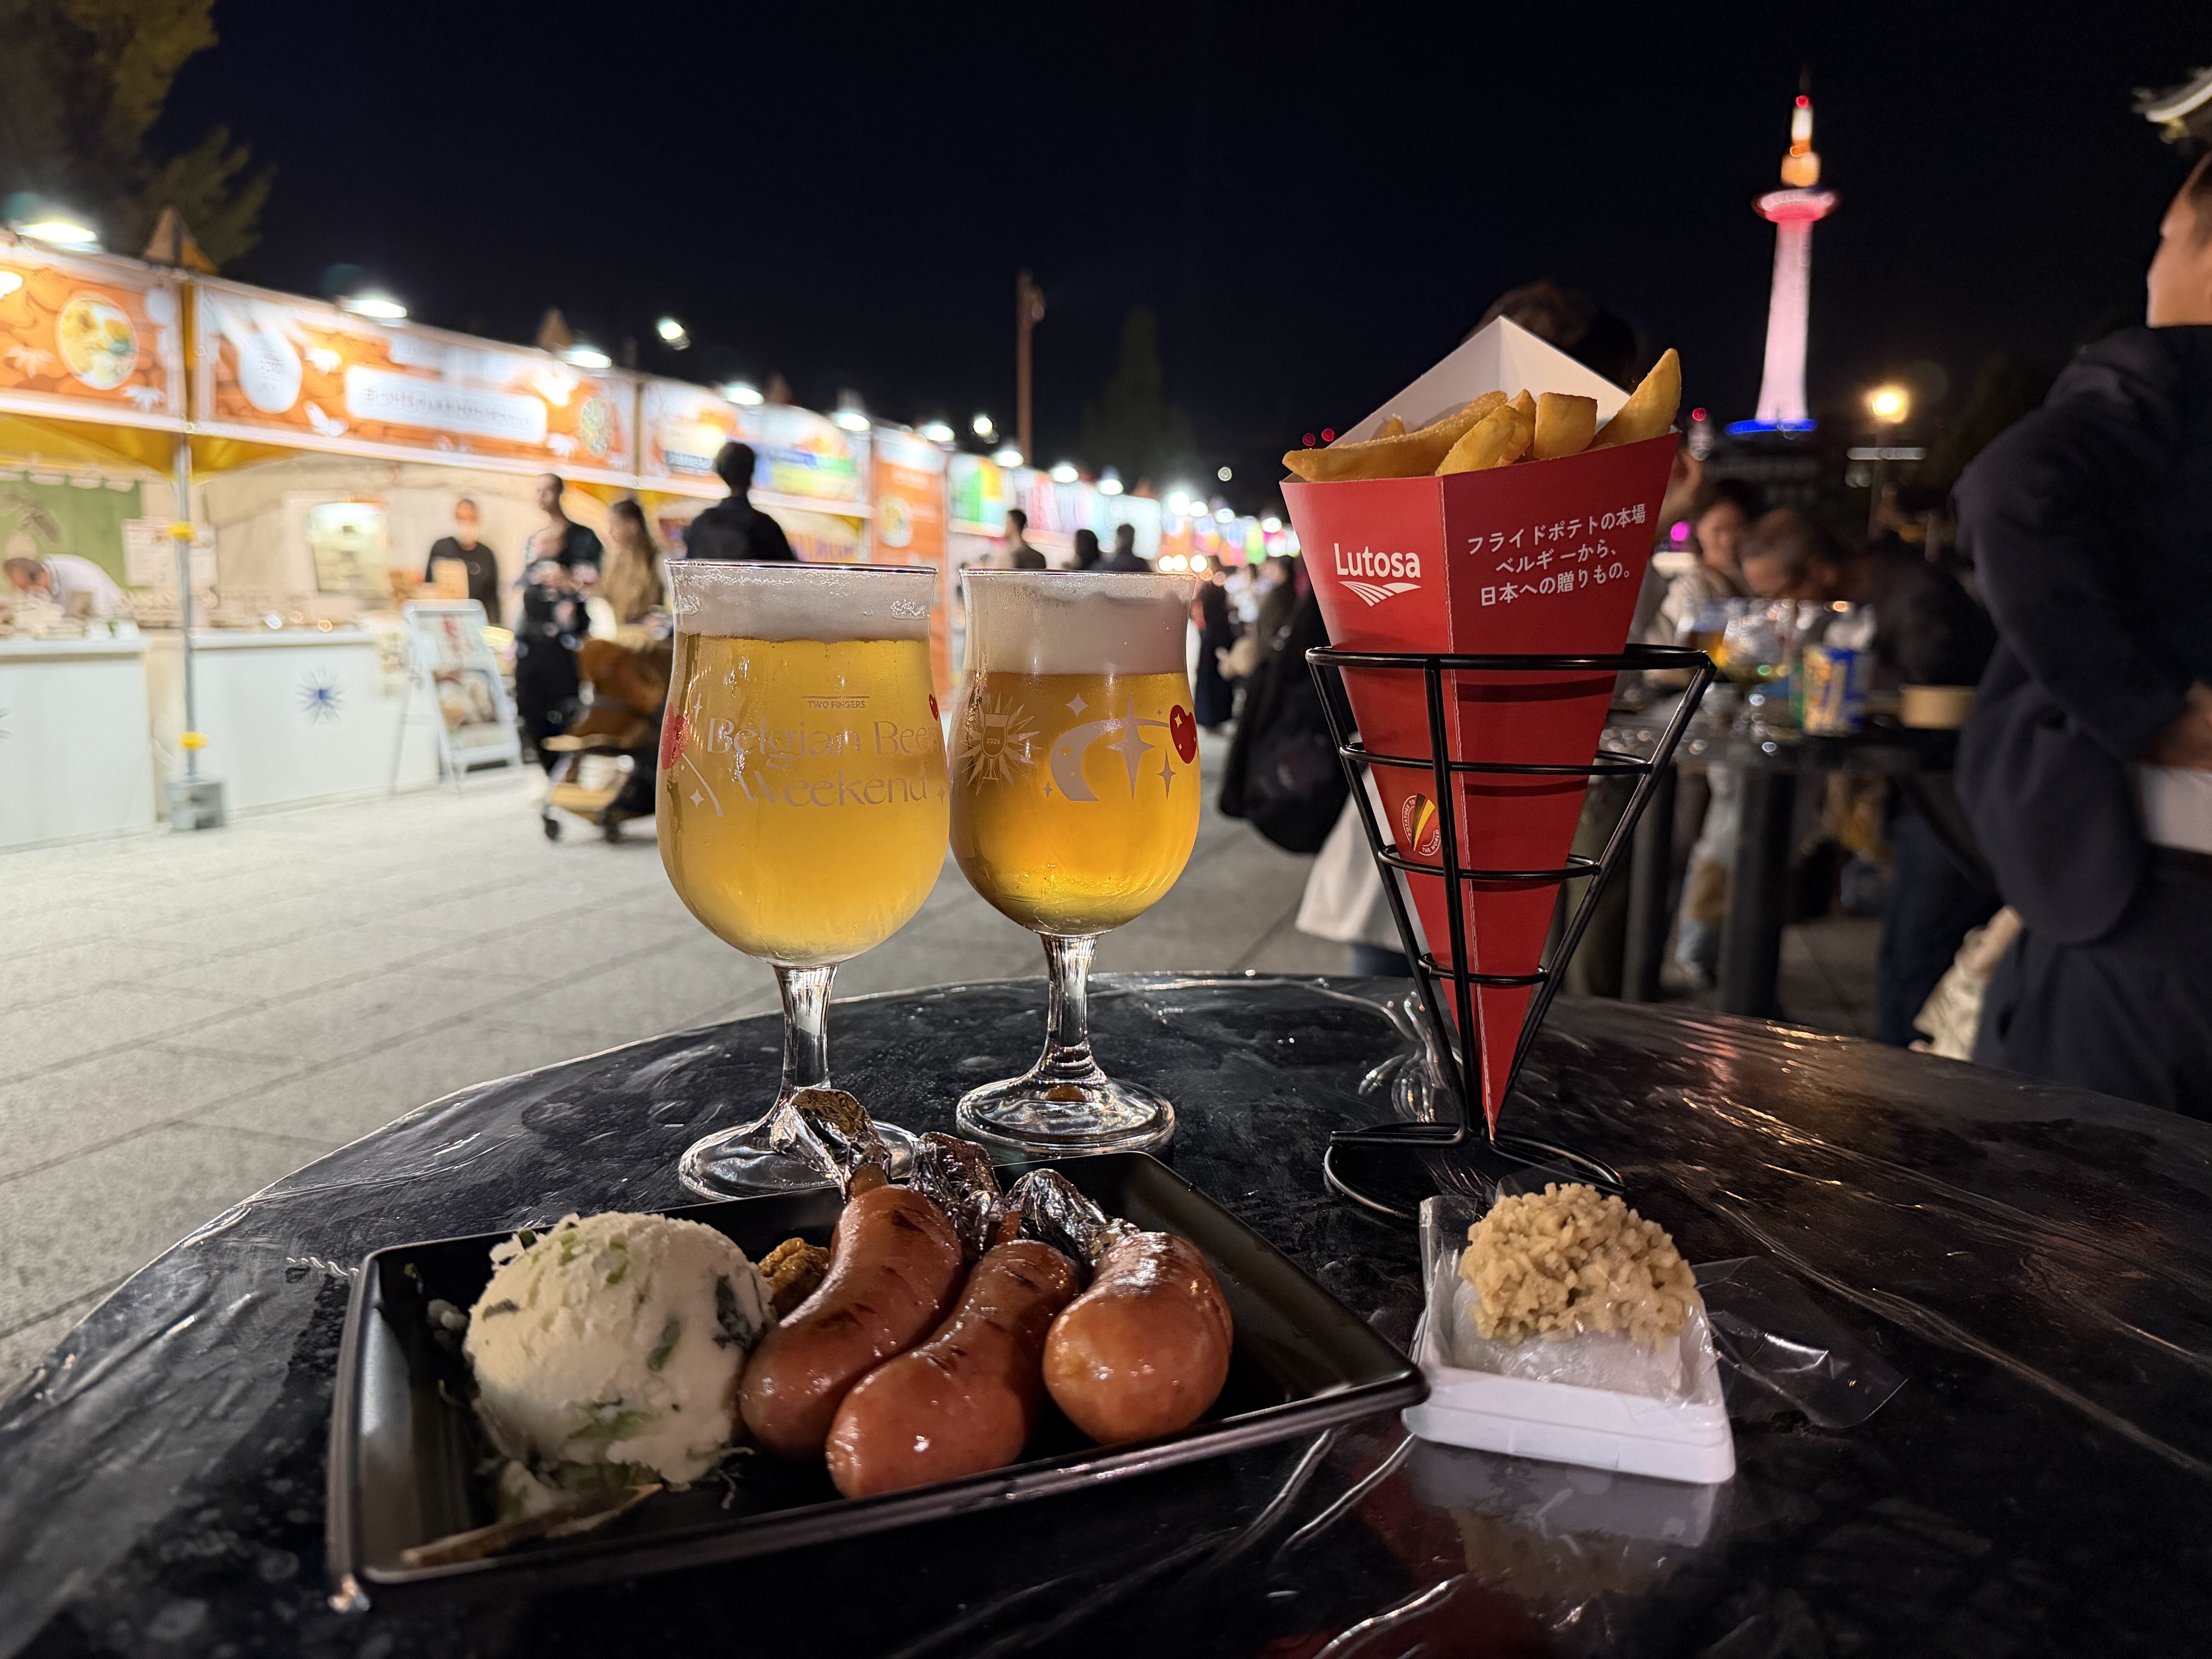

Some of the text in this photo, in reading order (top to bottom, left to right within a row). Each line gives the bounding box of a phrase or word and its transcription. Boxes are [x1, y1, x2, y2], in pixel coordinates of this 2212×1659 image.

[1467, 503, 1646, 555] フライドポテトの本場
[1333, 543, 1421, 579] Lutosa
[1495, 538, 1618, 573] ベルギーから、
[1480, 562, 1630, 606] 日本への贈りもの。
[707, 717, 860, 769] Belgian
[735, 762, 927, 807] Weekend
[1403, 804, 1412, 837] POTATOES
[1431, 829, 1439, 850] WORLD
